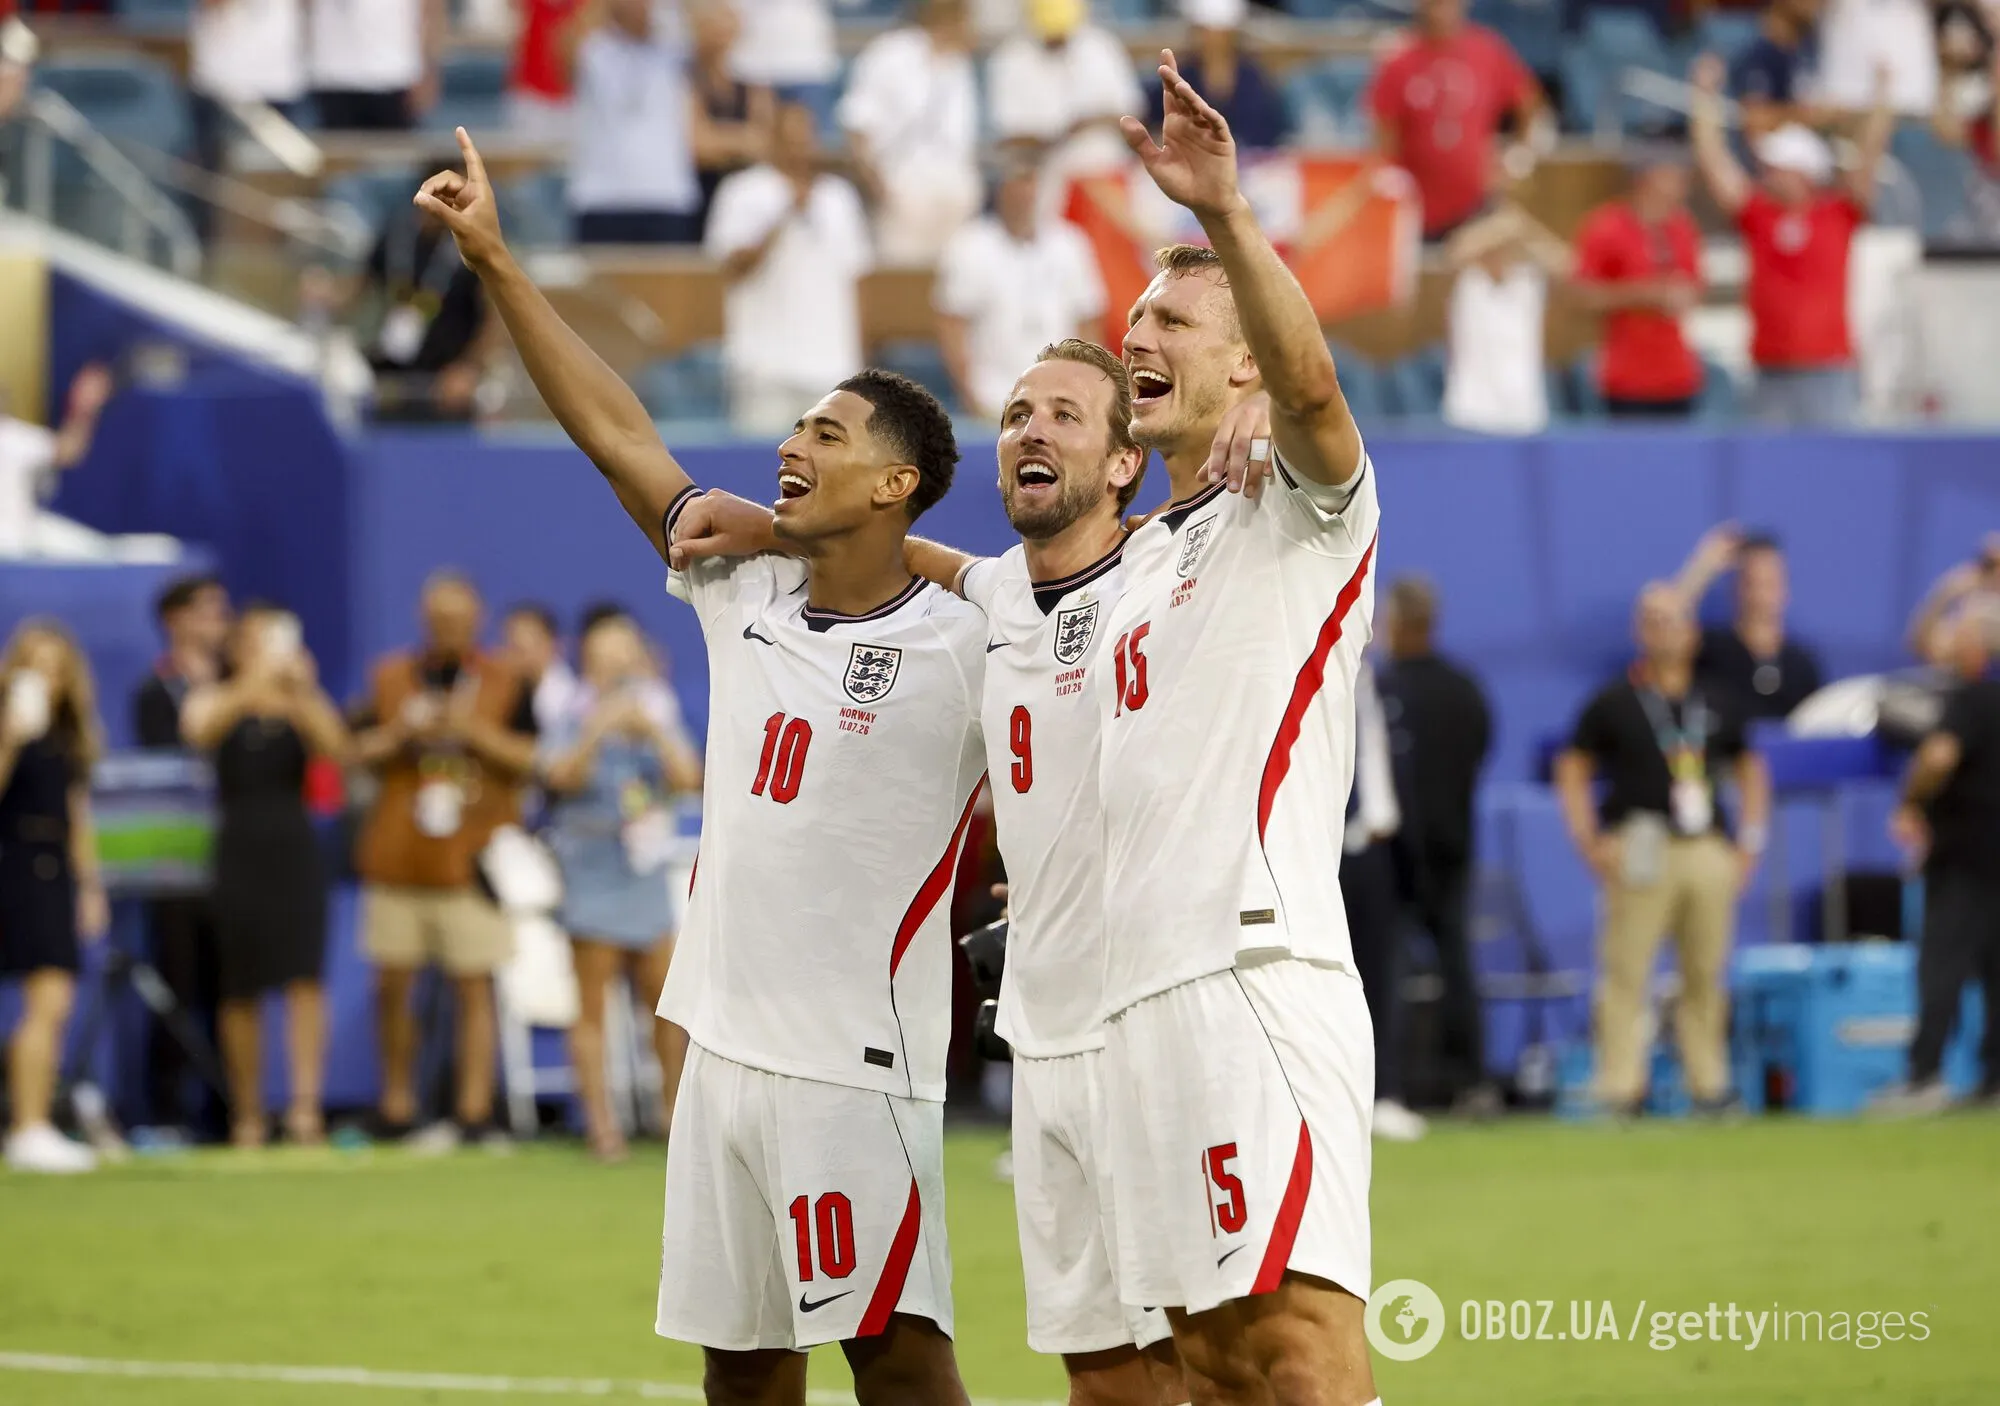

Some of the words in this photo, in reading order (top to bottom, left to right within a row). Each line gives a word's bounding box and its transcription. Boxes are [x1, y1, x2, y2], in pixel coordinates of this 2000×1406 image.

[1054, 667, 1086, 685] NORWAY
[1056, 682, 1082, 697] 11.07.26
[1113, 620, 1151, 719] 15
[838, 707, 877, 724] NORWAY
[838, 720, 870, 735] 11.07.26
[751, 711, 813, 804] 10
[1010, 705, 1033, 794] 9
[789, 1191, 857, 1282] 10
